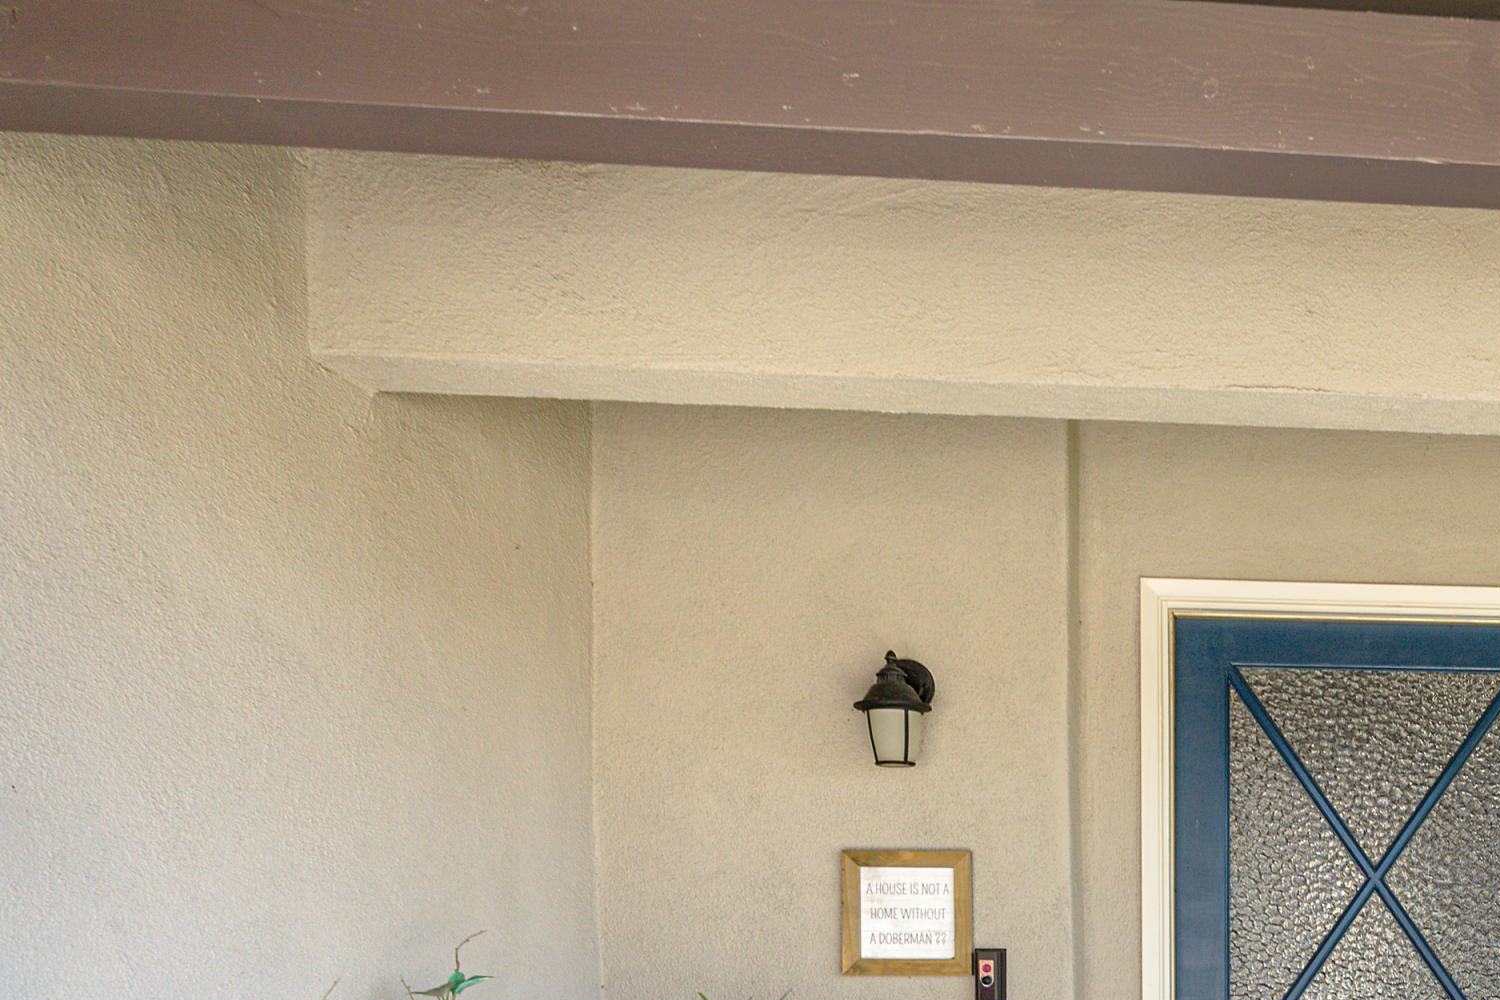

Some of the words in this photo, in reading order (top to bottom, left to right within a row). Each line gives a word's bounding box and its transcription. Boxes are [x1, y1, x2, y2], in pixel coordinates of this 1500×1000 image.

[866, 882, 873, 895] A
[876, 882, 907, 895] HOUSE
[910, 882, 919, 895] IS
[921, 883, 940, 895] NOT
[943, 883, 949, 895] A
[870, 907, 898, 920] HOME
[900, 907, 946, 920] WITHOUT
[870, 932, 877, 944] A
[879, 932, 932, 945] DOBERMAN
